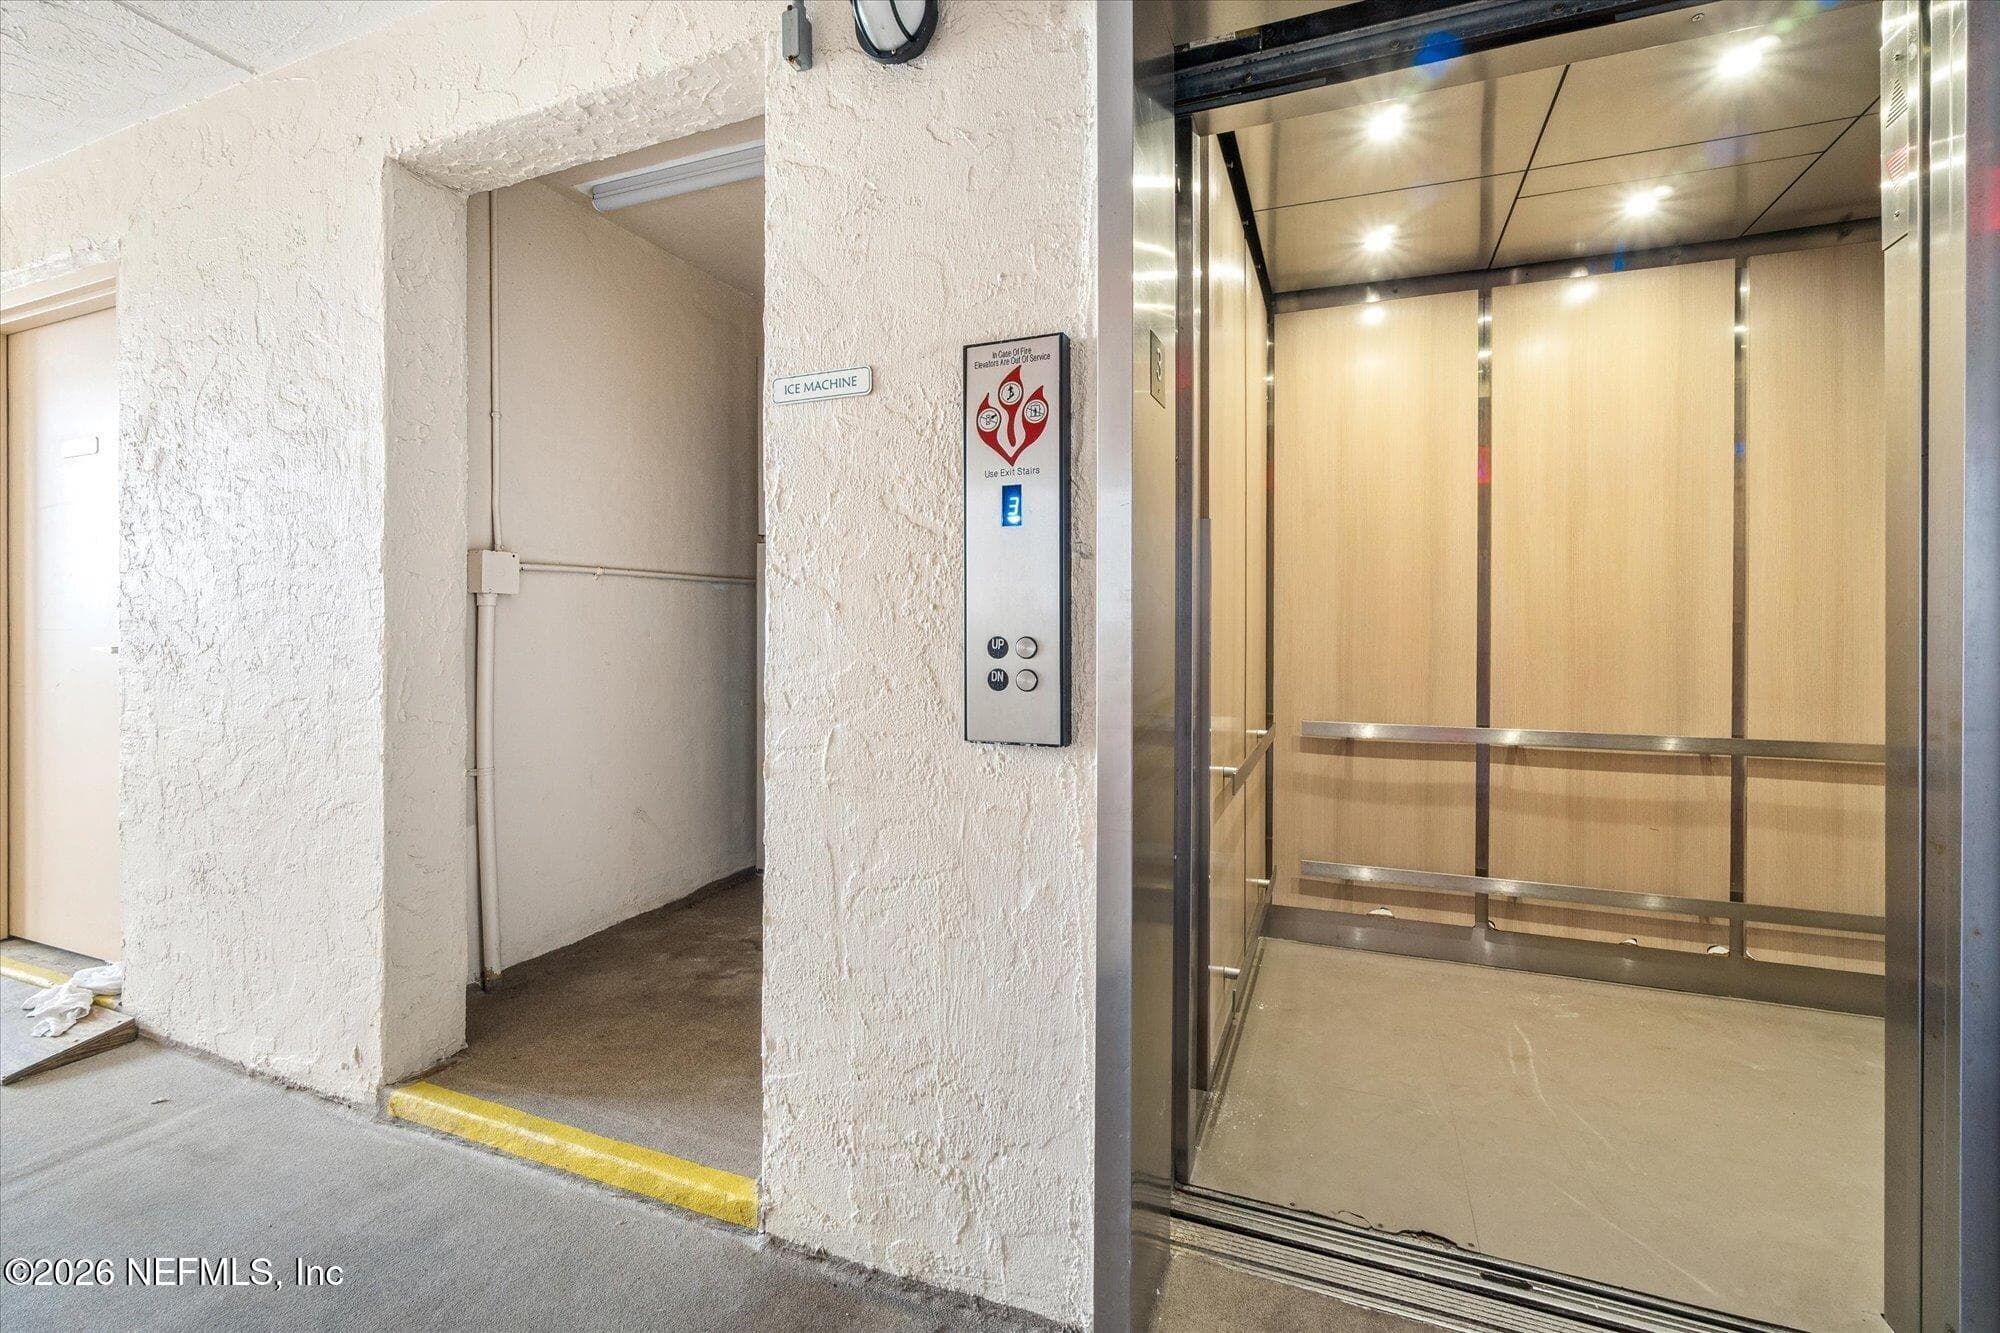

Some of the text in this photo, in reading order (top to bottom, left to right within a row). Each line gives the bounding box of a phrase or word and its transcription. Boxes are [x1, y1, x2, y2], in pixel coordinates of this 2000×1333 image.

[998, 350, 1011, 358] Case
[1012, 348, 1020, 356] Of
[1020, 346, 1032, 355] Fire
[974, 360, 1000, 370] Elevators
[1010, 356, 1020, 364] Out
[1022, 355, 1028, 363] Of
[1030, 353, 1050, 362] Service
[1156, 347, 1162, 382] 3
[784, 376, 858, 395] ICE MACHINE
[984, 466, 1040, 478] Use Exit Stairs
[1008, 496, 1020, 516] 3
[992, 638, 1004, 650] UP
[992, 670, 1004, 682] DN
